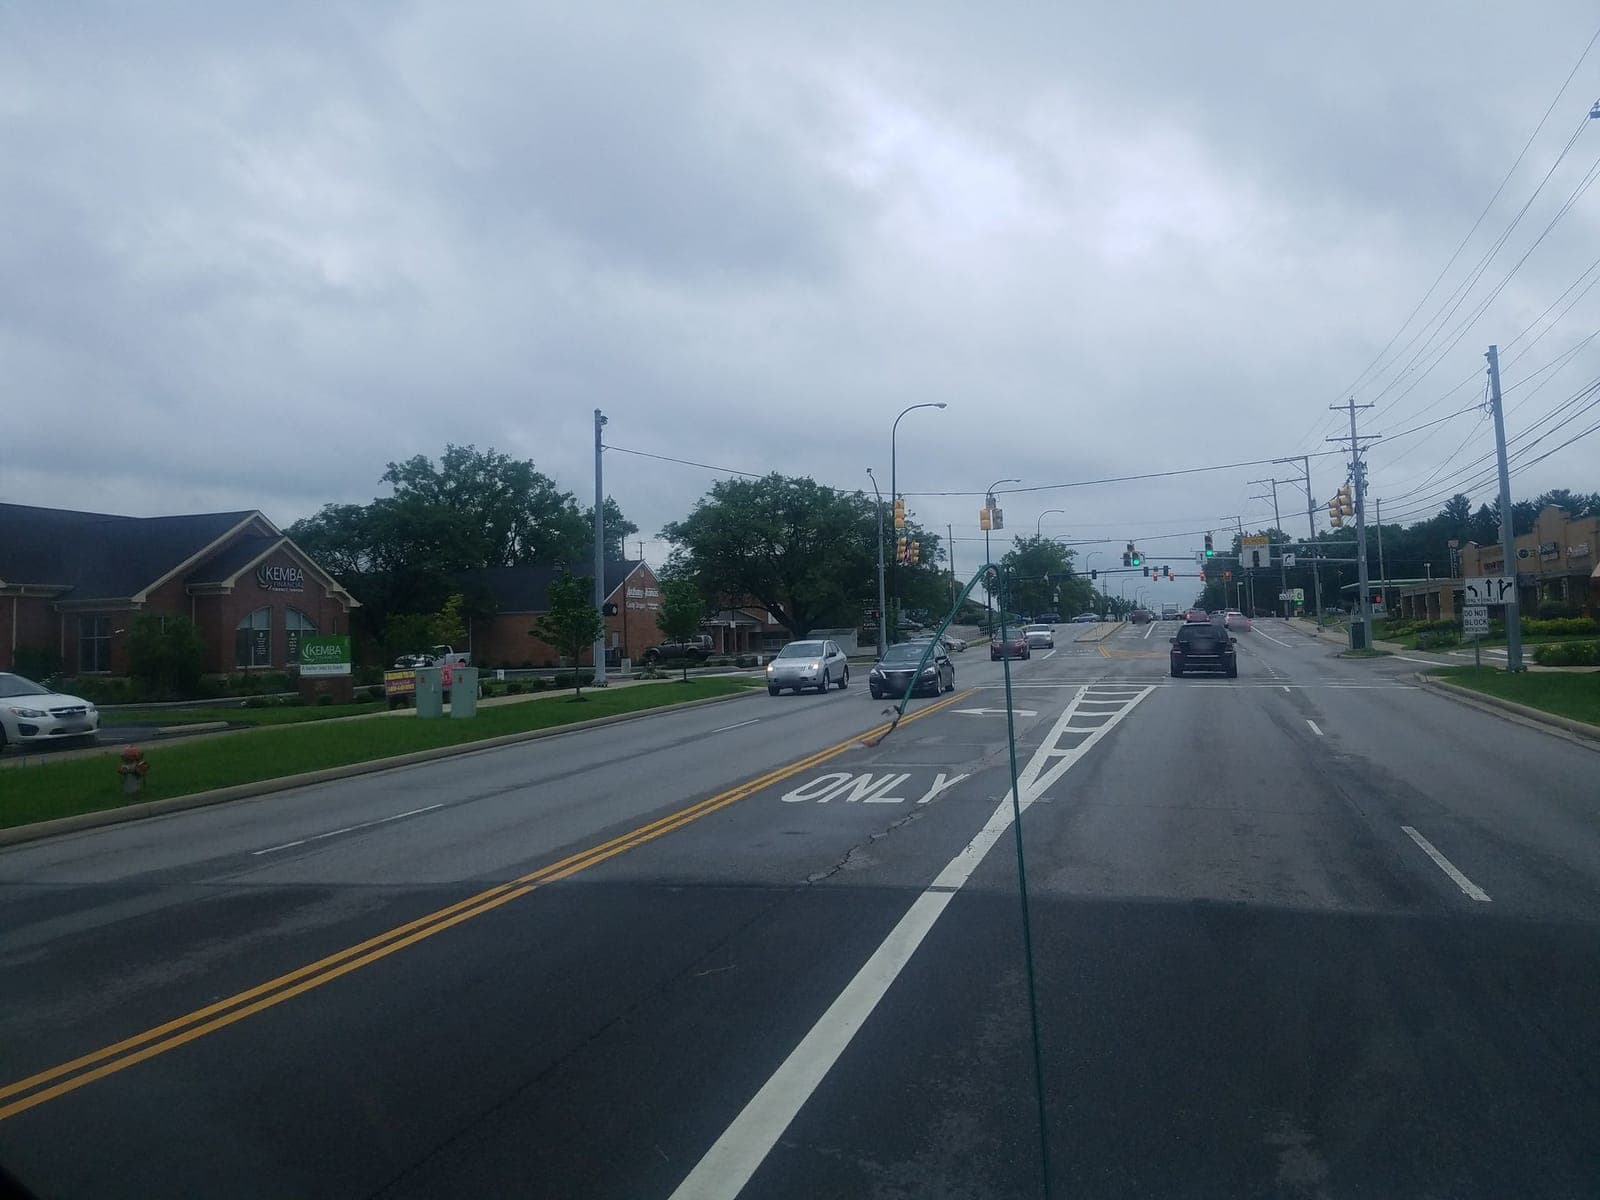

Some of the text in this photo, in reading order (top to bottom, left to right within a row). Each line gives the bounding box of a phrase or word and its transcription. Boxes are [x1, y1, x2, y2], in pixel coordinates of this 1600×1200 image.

[265, 566, 304, 581] KEMBA
[309, 645, 342, 656] KEMBA
[781, 772, 970, 803] ONLY
